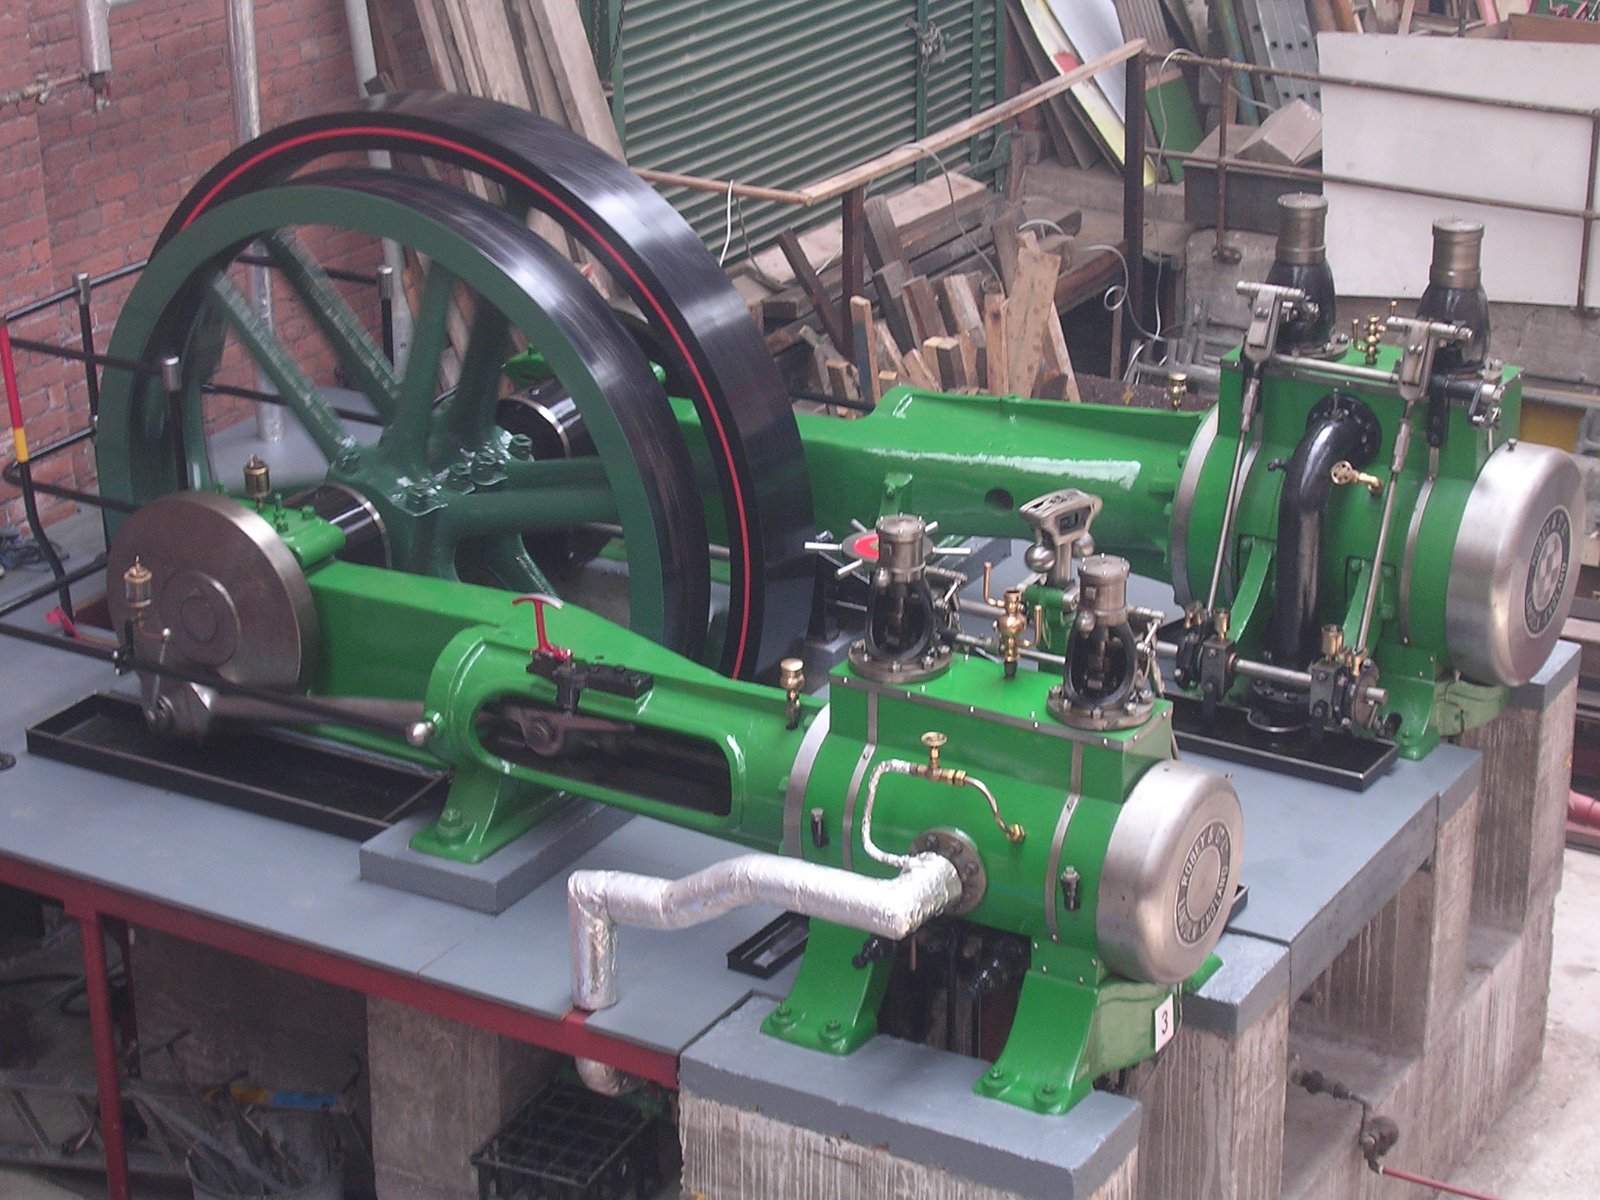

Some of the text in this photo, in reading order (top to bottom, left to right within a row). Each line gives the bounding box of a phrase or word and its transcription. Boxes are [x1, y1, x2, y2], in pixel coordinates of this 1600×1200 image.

[1181, 831, 1206, 887] ROBEY
[1207, 824, 1214, 844] &
[1161, 1010, 1168, 1035] 3
